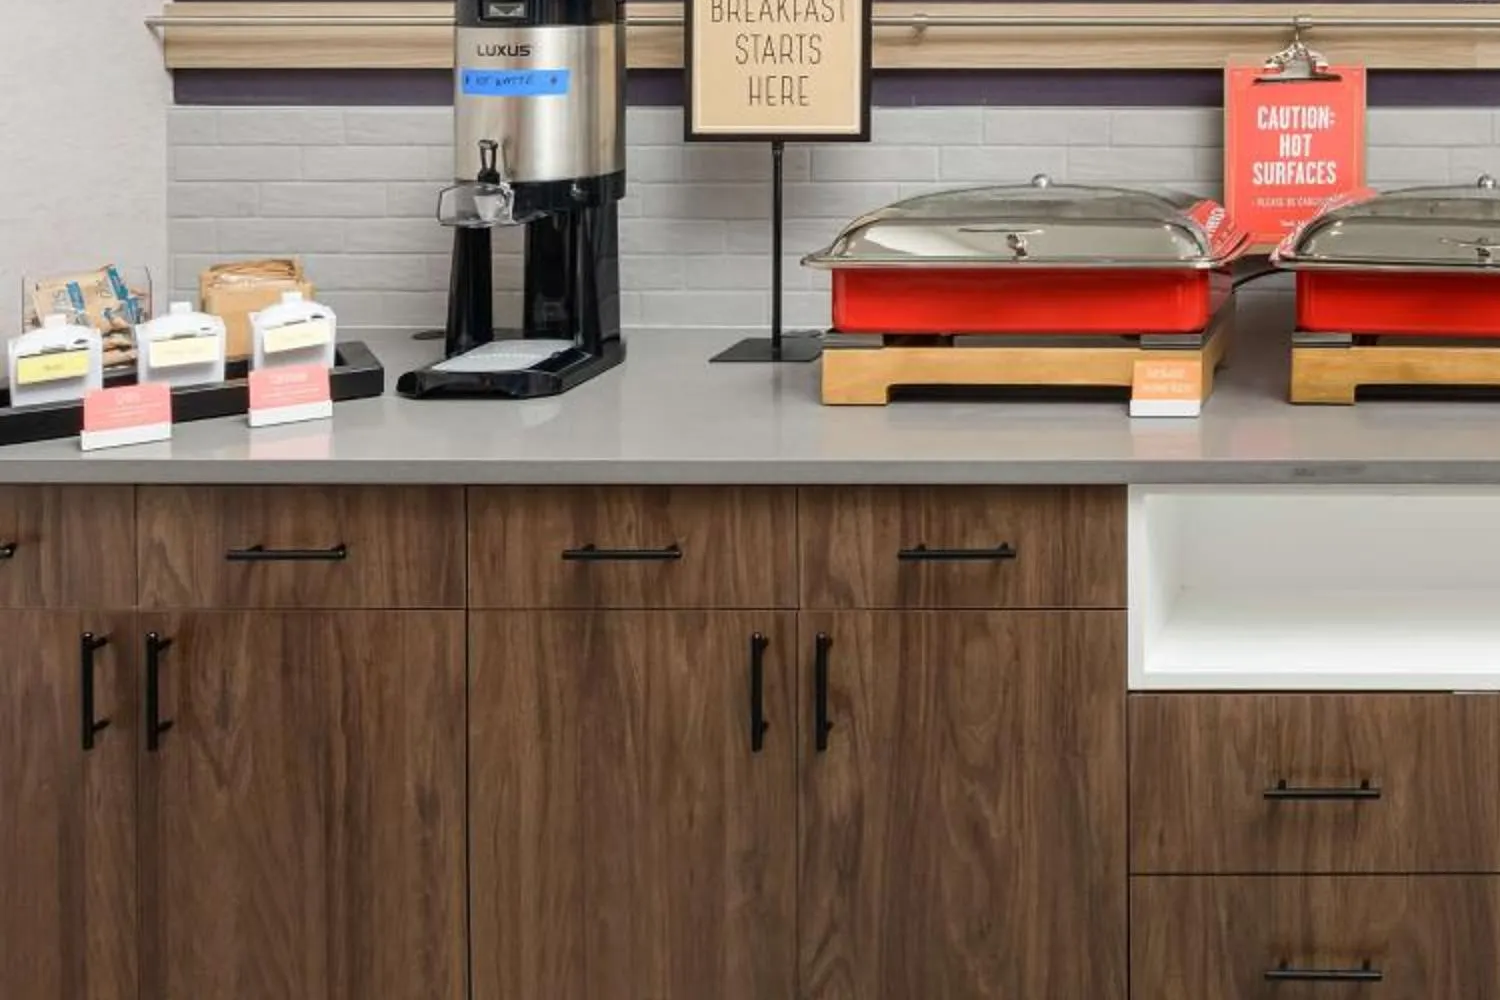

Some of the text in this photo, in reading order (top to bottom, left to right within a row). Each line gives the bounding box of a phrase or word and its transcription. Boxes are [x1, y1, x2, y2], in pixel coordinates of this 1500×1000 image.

[477, 44, 532, 57] LUXUS
[735, 34, 822, 65] STARTS
[748, 75, 810, 107] HERE
[1257, 105, 1336, 130] CAUTION:
[1279, 133, 1313, 157] HOT
[1252, 160, 1337, 185] SURFACES
